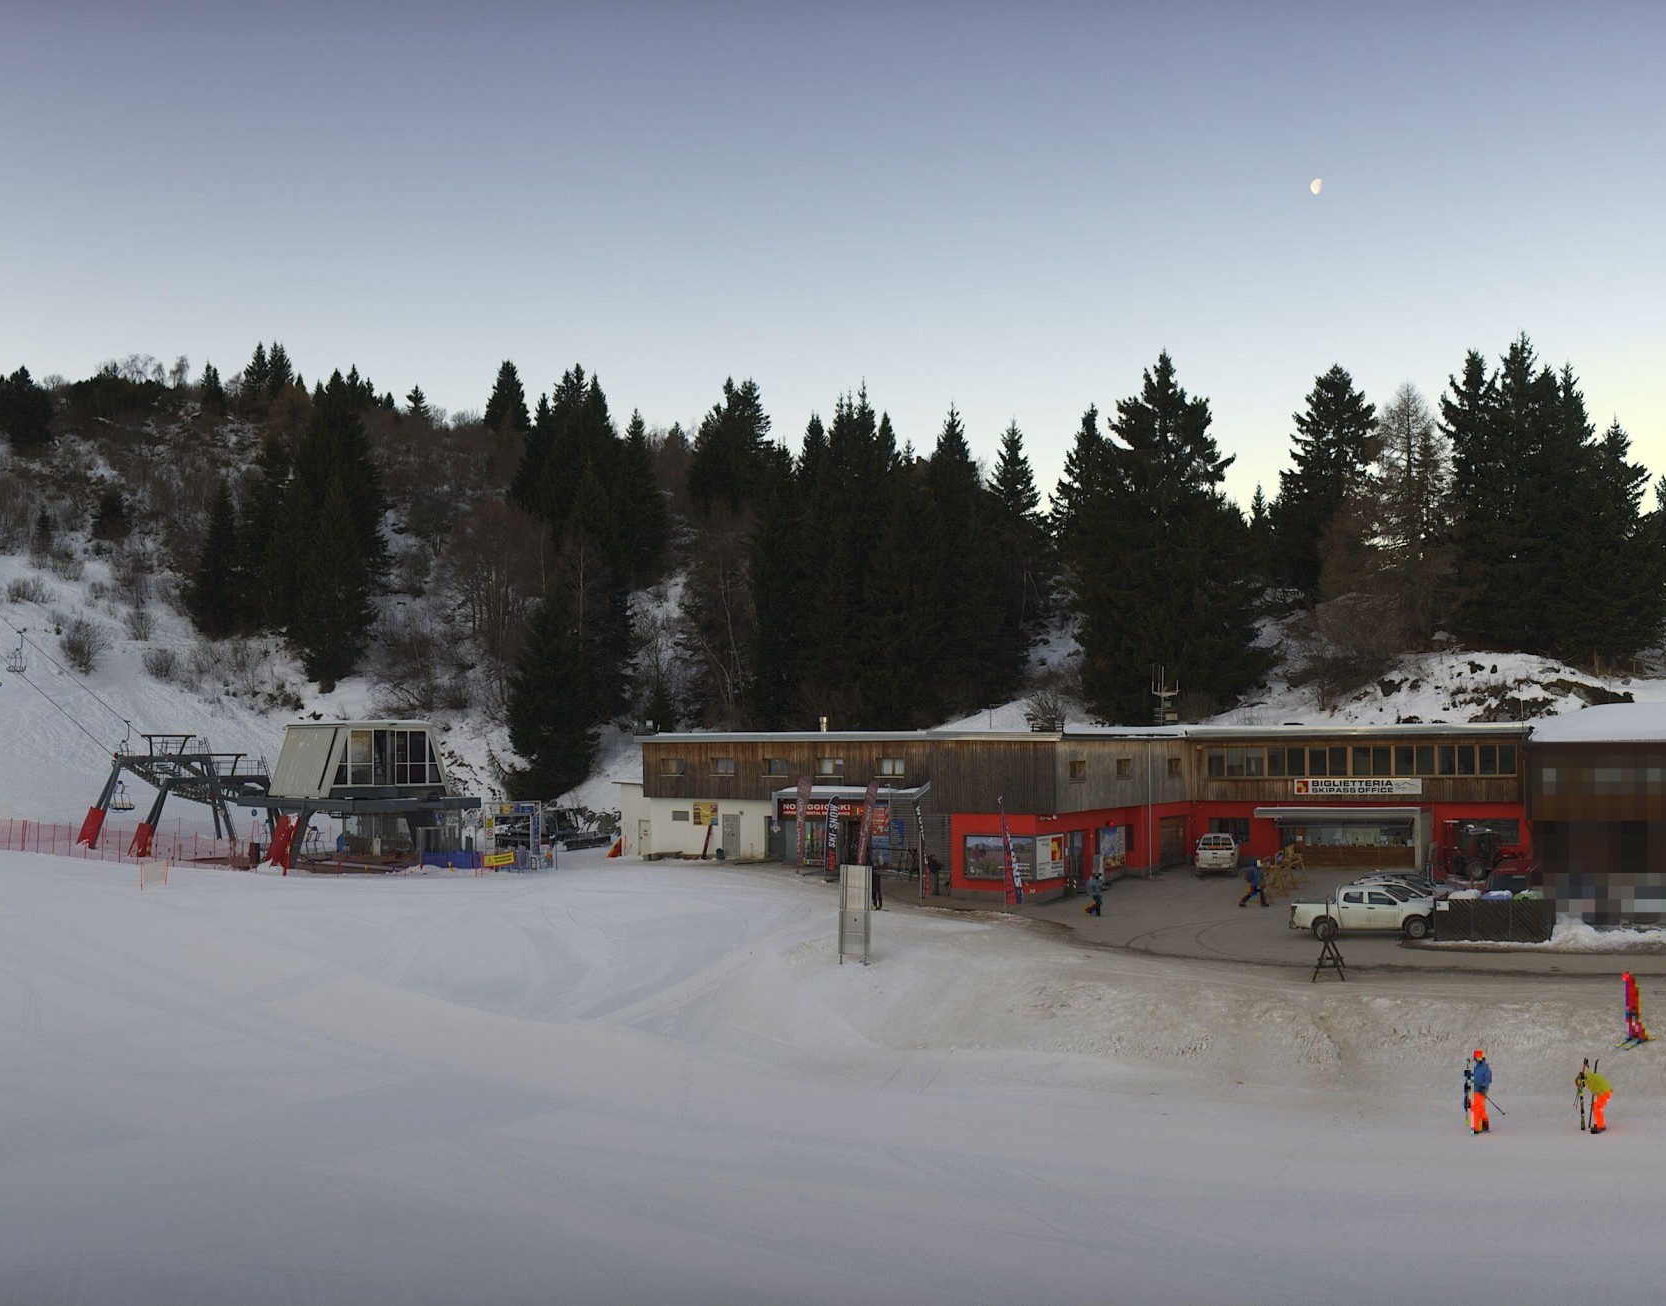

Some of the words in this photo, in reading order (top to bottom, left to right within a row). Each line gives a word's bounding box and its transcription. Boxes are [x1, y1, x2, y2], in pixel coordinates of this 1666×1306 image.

[1311, 779, 1394, 787] BIGLIETTERIA
[782, 803, 830, 811] NOGGIO
[828, 803, 839, 849] SKI-SNOW
